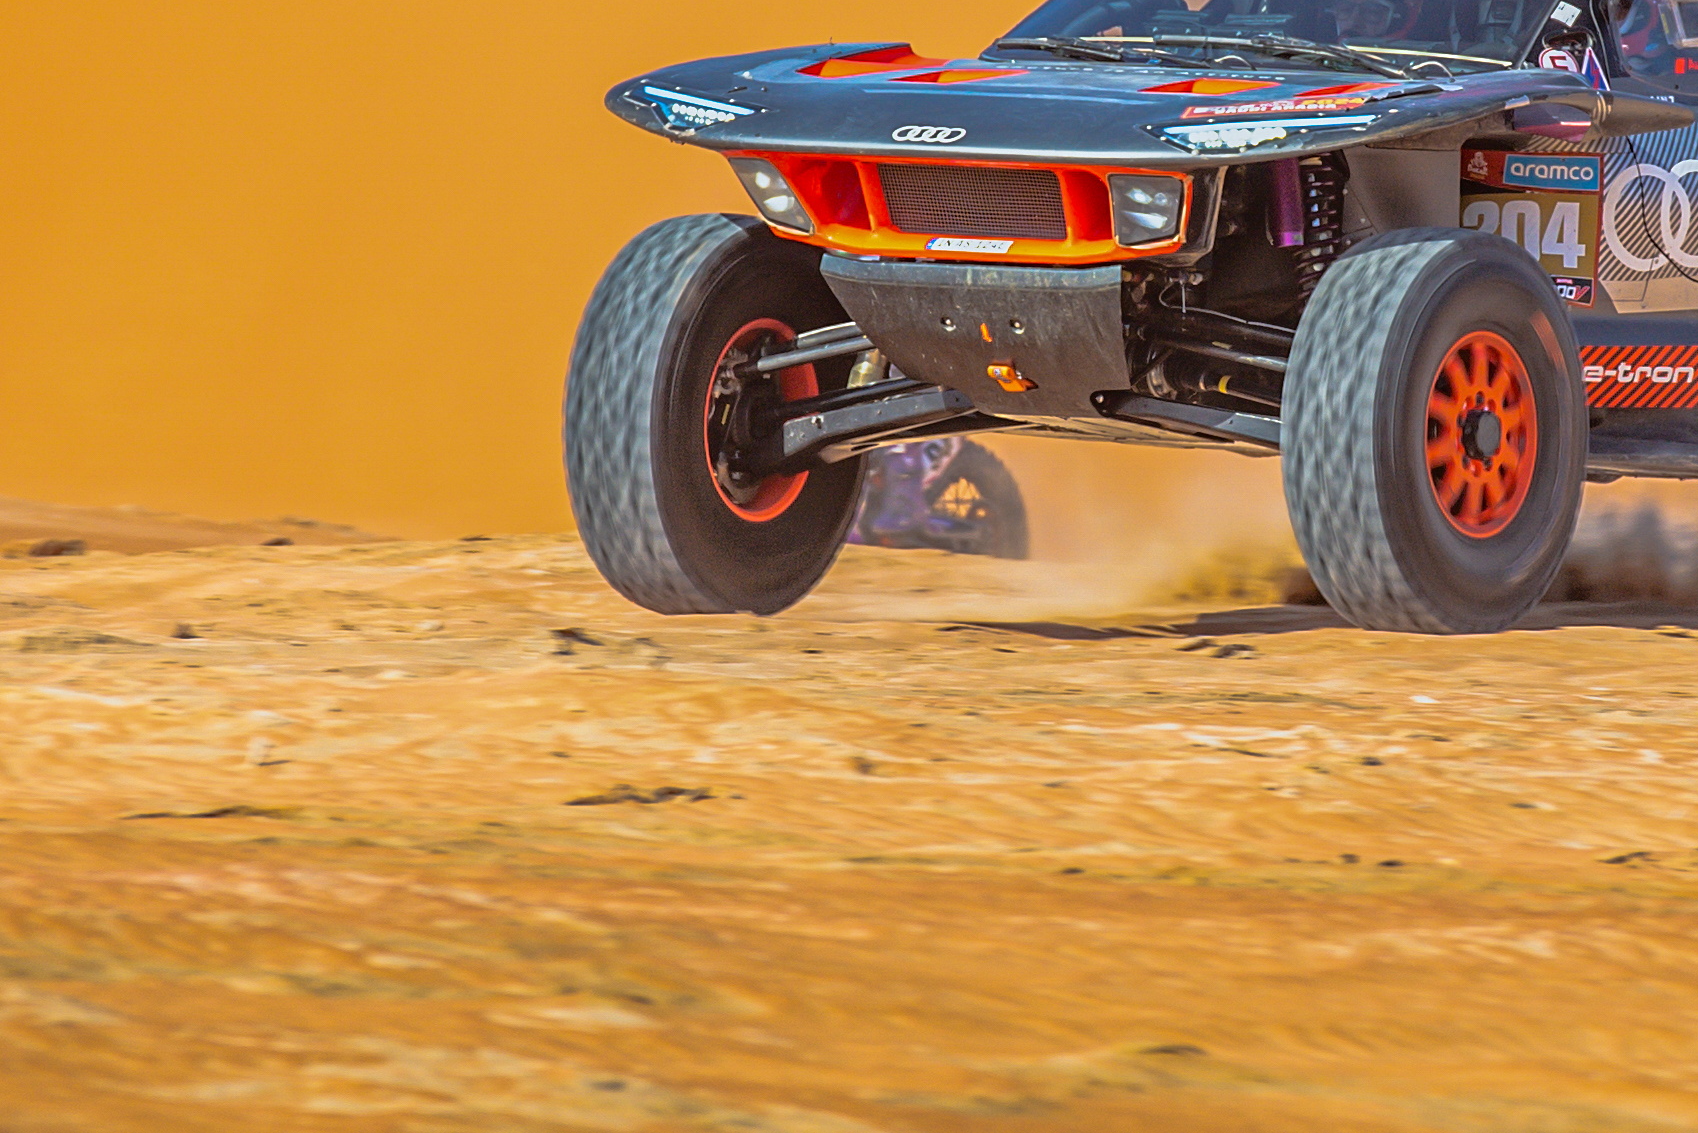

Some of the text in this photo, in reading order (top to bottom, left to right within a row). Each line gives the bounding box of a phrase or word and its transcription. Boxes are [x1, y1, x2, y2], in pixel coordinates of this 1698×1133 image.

[1510, 162, 1594, 180] aramco
[1462, 200, 1586, 269] 204
[1552, 284, 1591, 301] 00V
[1582, 362, 1694, 383] e-tron
